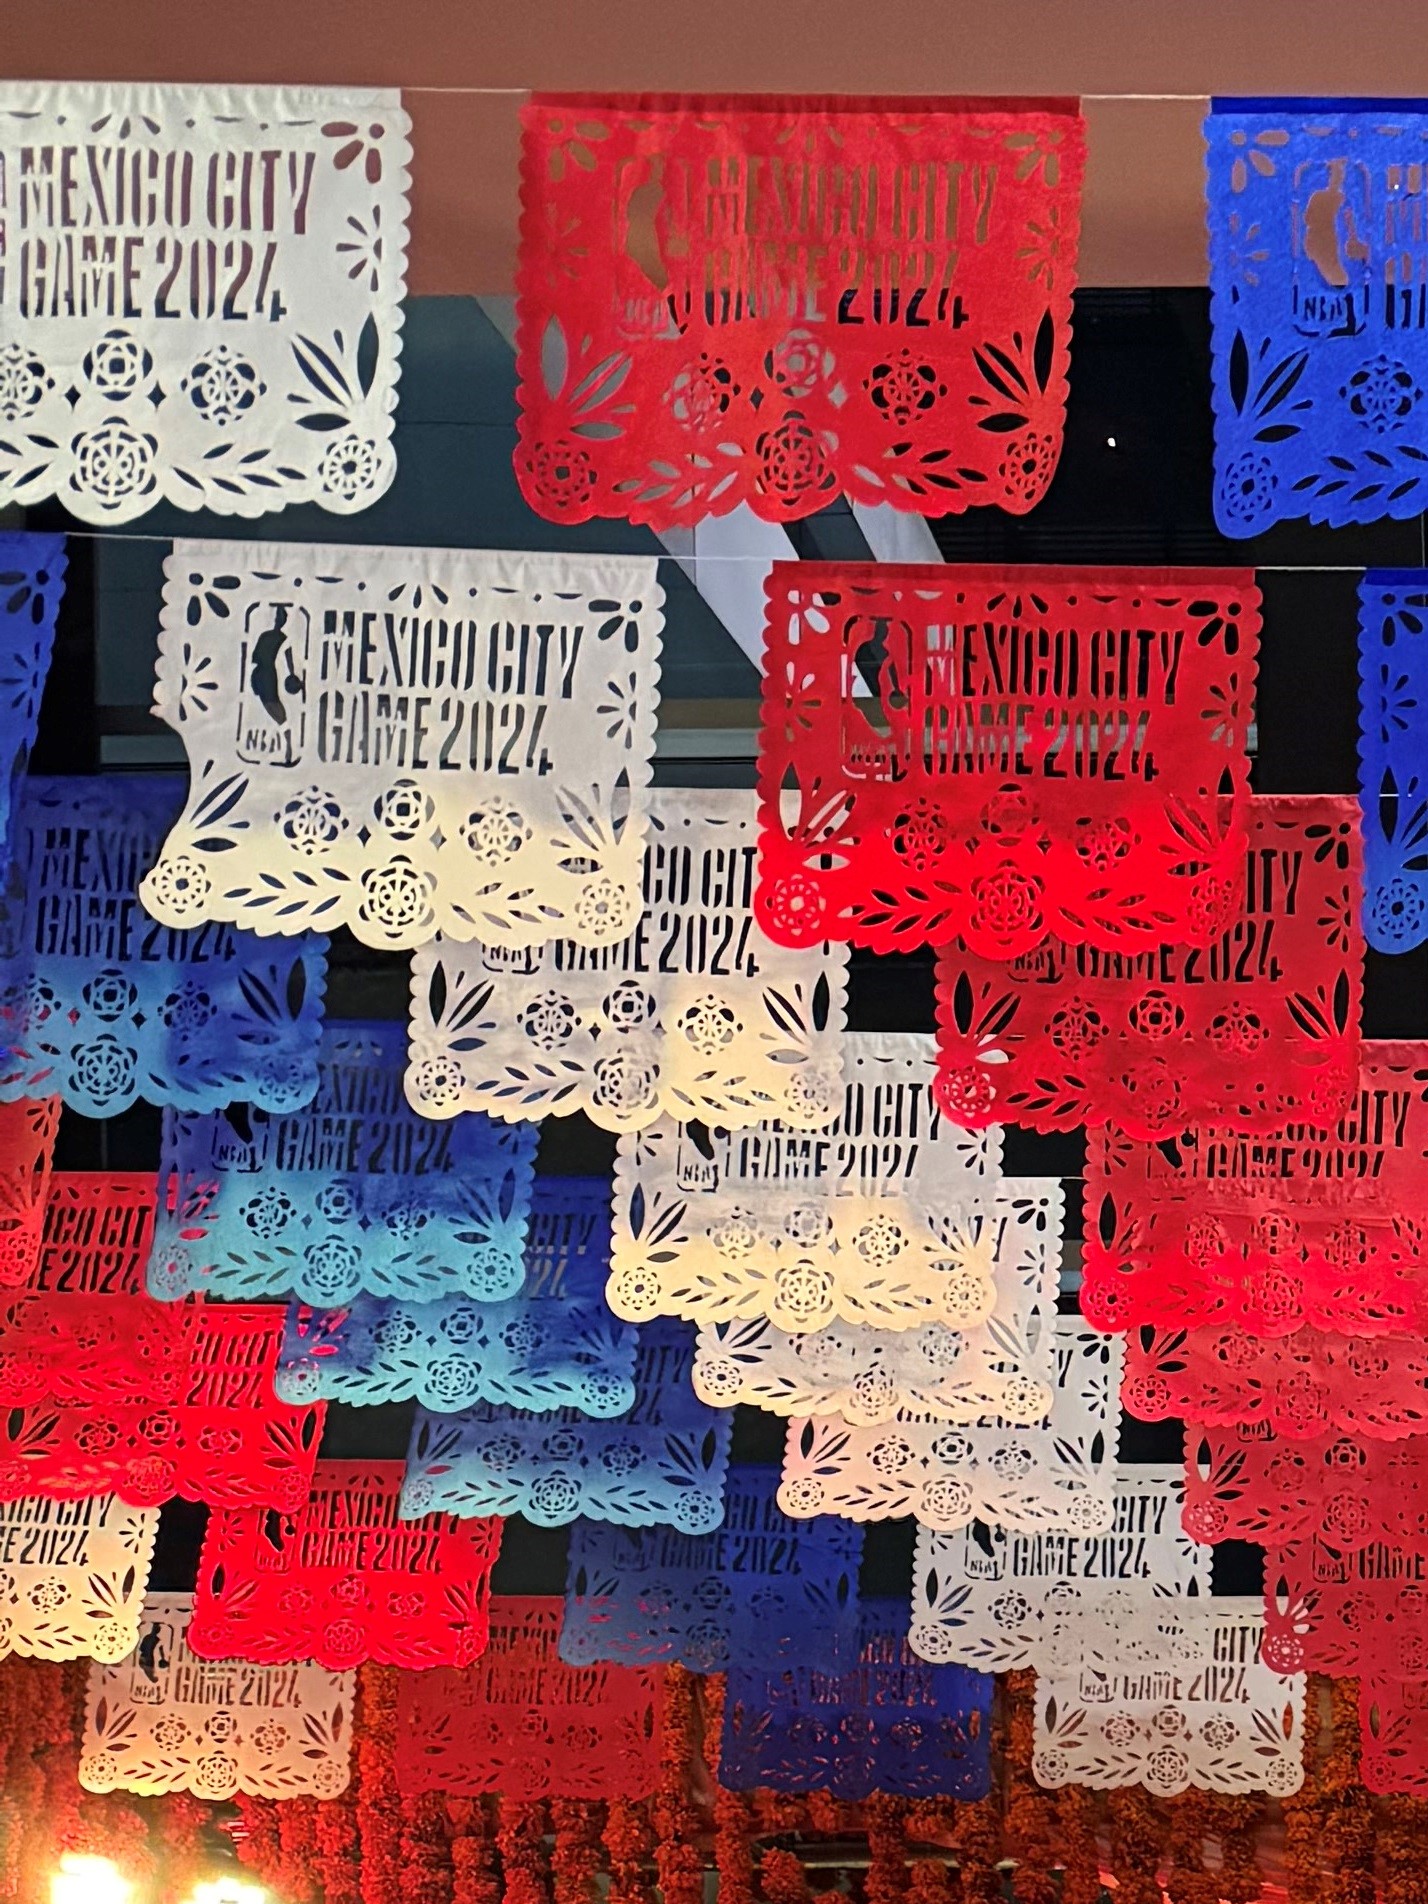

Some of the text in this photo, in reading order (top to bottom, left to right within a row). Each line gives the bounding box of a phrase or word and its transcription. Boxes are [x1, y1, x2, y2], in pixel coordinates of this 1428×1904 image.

[20, 145, 316, 236] MEXICO CITY
[704, 155, 998, 244] MEXICO CITY
[19, 237, 287, 323] GAME 2024
[702, 245, 970, 330] GAME 2024
[320, 609, 585, 700] MEXICO CITY
[924, 621, 1185, 705] MEXICO CITY
[317, 689, 554, 776] GAME 2024
[923, 704, 1161, 782] GAME 2024
[703, 845, 760, 909] CIT
[36, 896, 135, 961] GAME
[658, 913, 760, 976] 2024
[1183, 921, 1284, 983] 2024
[275, 1117, 455, 1177] GAME 2024
[57, 1251, 142, 1297] 2024
[185, 1372, 265, 1409] 2024
[19, 1529, 89, 1567] 2024
[301, 1531, 442, 1576] GAME 2024
[660, 1533, 802, 1576] GAME 2024
[1012, 1536, 1152, 1579] GAME 2024
[1358, 1541, 1426, 1581] GAME
[174, 1665, 304, 1709] GAME 2024
[1187, 1665, 1251, 1704] 2024
